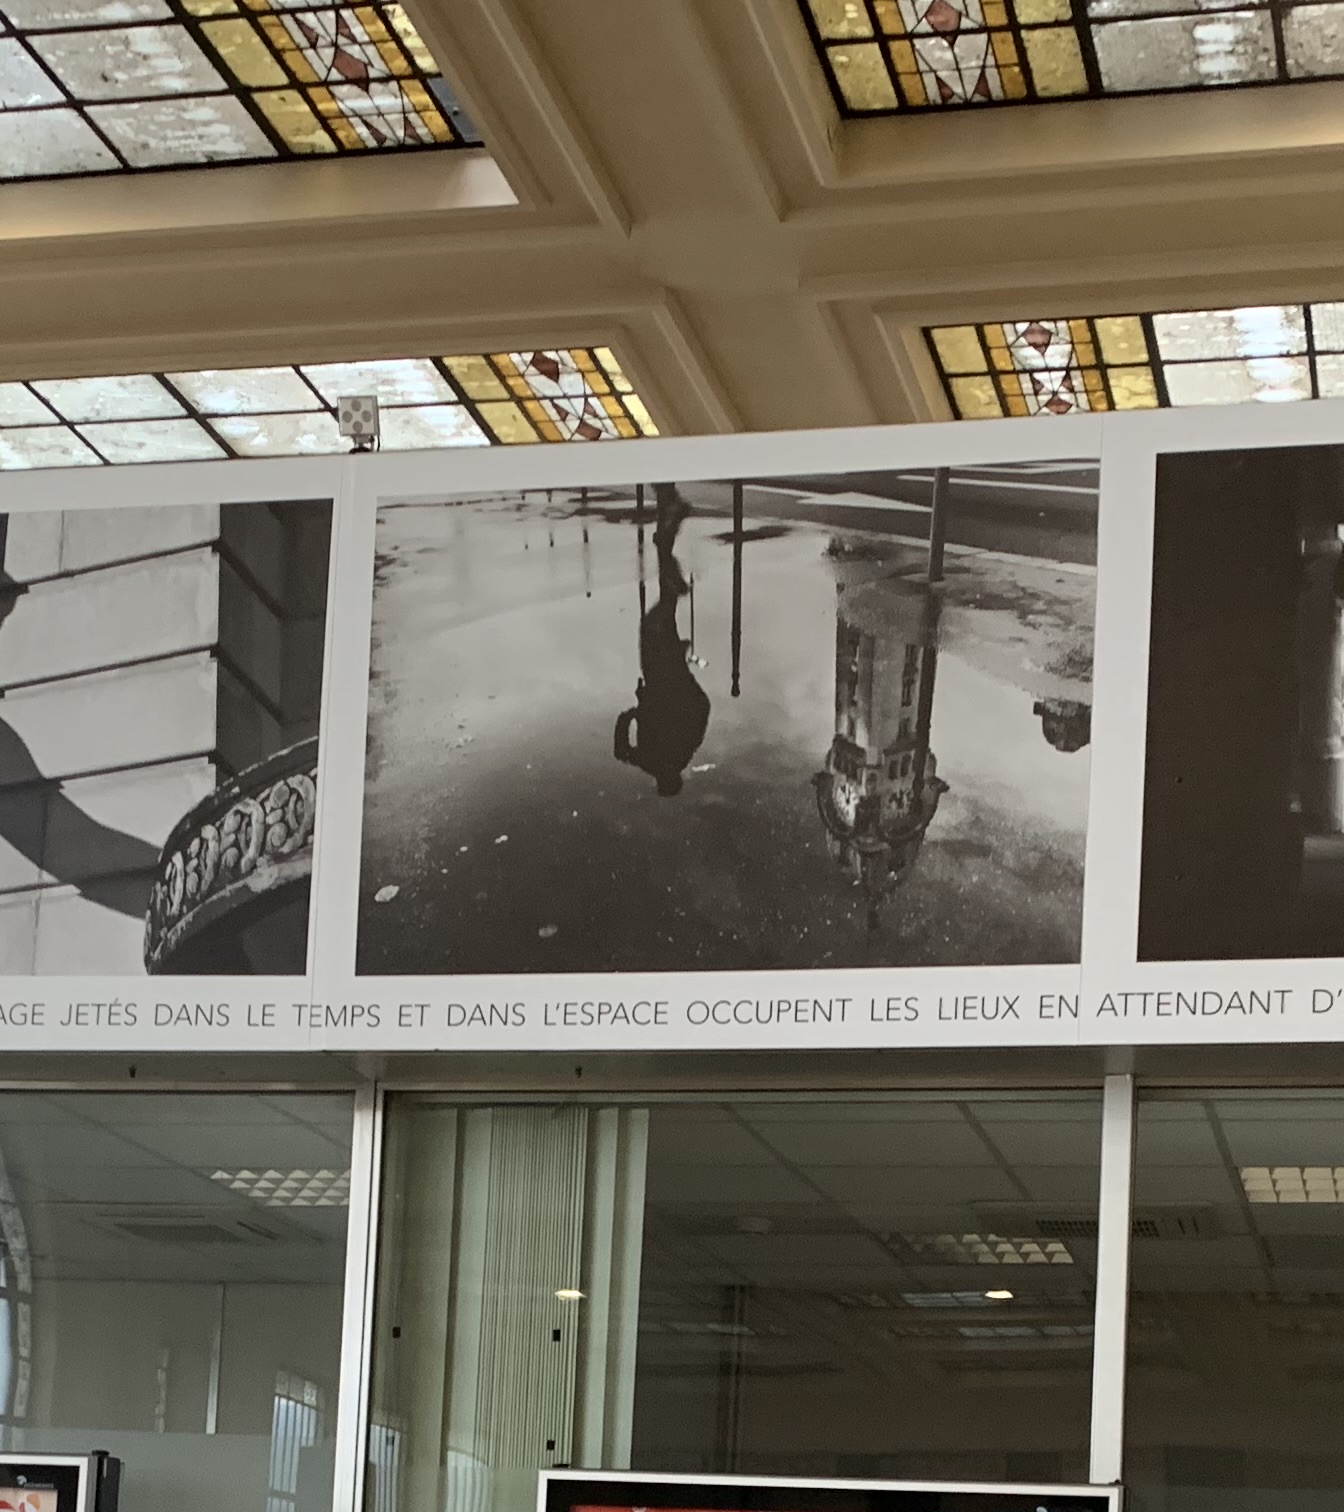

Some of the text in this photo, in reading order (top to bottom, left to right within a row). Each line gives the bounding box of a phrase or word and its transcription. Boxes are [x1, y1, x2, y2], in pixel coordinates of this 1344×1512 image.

[60, 997, 137, 1027] JETÉS
[154, 1003, 230, 1027] DANS
[247, 1003, 276, 1027] LE
[292, 1003, 380, 1028] TEMPS
[398, 1003, 431, 1027] ET
[447, 1002, 526, 1027] DANS
[544, 1001, 669, 1026] L'ESPACE
[687, 998, 853, 1025] OCCUPENT
[871, 996, 919, 1022] LES
[938, 995, 1020, 1021] LIEUX
[1039, 991, 1081, 1019] EN
[1096, 989, 1293, 1017] ATTENDANT
